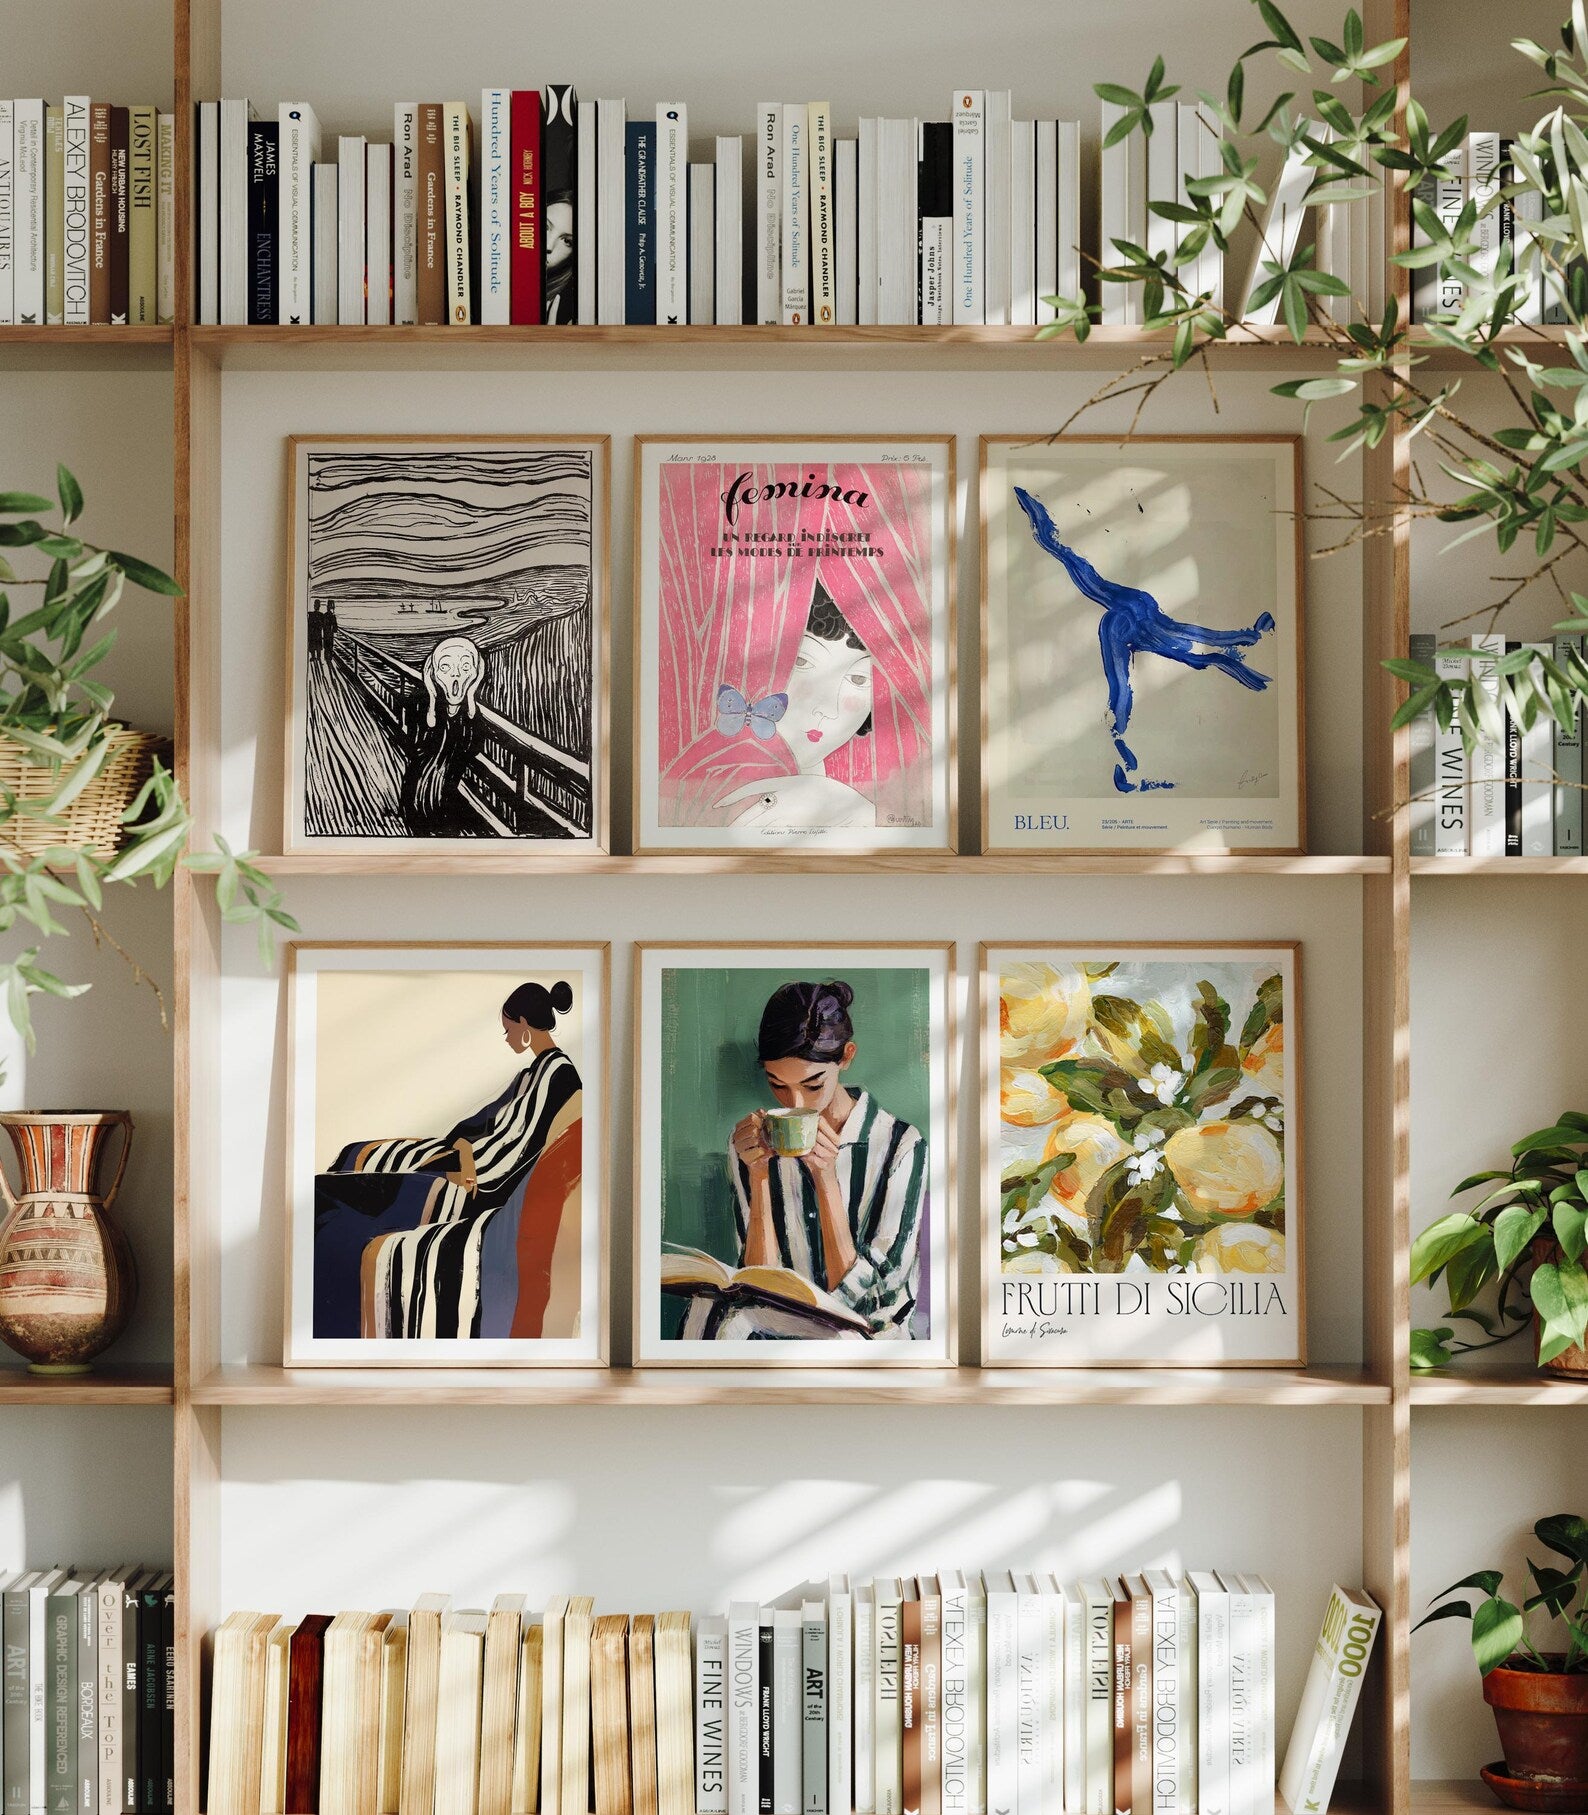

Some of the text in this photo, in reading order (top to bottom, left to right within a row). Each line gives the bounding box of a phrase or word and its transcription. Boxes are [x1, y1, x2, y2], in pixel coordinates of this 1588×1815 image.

[29, 119, 39, 139] Detail
[66, 102, 87, 179] ALEXEY
[452, 115, 460, 132] THE
[817, 115, 825, 132] THE
[28, 148, 39, 194] Contemporary
[133, 112, 152, 208] LOST FISH
[254, 133, 265, 184] MAXWELL
[265, 140, 276, 176] JAMES
[291, 128, 299, 172] ESSENTIALS
[453, 155, 461, 182] SLEEP
[523, 149, 533, 185] NICK HORNBY
[669, 128, 677, 172] ESSENTIALS
[818, 155, 826, 182] SLEEP
[118, 149, 126, 233] NEW URBAN HOUSING
[291, 172, 299, 183] OF
[291, 184, 299, 209] VISUAL
[402, 113, 413, 280] Ron Arad No Discipline
[490, 92, 502, 294] Hundred Years of Solitude
[519, 191, 535, 209] BOY
[638, 135, 646, 225] THE GRANDFATHER CLAUSE
[669, 172, 677, 183] OF
[669, 184, 677, 209] VISUAL
[765, 113, 776, 280] Ron Arad No Discipline
[791, 124, 801, 268] One Hundred Years of Solitude
[29, 195, 39, 232] Residential
[95, 171, 107, 269] Gardens in France
[427, 172, 437, 268] Gardens in France
[454, 194, 463, 244] RAYMOND
[519, 221, 535, 250] ABOUT
[819, 194, 828, 244] RAYMOND
[963, 156, 974, 309] One Hundred Years of Solitude
[29, 233, 39, 272] Architecture
[66, 186, 87, 314] BRODOVITCH
[291, 209, 299, 272] COMMUNICATION
[669, 209, 677, 272] COMMUNICATION
[256, 232, 272, 321] ENCHANTRESS
[456, 247, 464, 298] CHANDLER
[821, 247, 829, 298] CHANDLER
[927, 246, 937, 307] Jasper Johns
[721, 471, 870, 527] femina
[710, 547, 733, 557] LES
[738, 547, 783, 557] MODES
[787, 547, 804, 557] DE
[723, 533, 740, 542] UN
[744, 533, 796, 542] REGARD
[1509, 734, 1517, 758] LLOYD
[1441, 747, 1464, 830] WINES
[1014, 815, 1070, 830] BLEU.
[1001, 1281, 1288, 1317] FRUTTI DI SICILIA
[7, 1644, 27, 1680] ART
[56, 1615, 68, 1662] GRAPHIC
[56, 1664, 68, 1703] DESIGN
[102, 1594, 117, 1761] Over the Top
[126, 1662, 137, 1691] EAMES
[146, 1643, 156, 1710] ARNE JACOBSEN
[166, 1646, 175, 1710] EERO SAARINEN
[734, 1627, 753, 1708] WINDOWS
[806, 1667, 824, 1700] ART
[81, 1681, 94, 1740] BORDEAUX
[702, 1660, 723, 1793] FINE WINES
[739, 1716, 748, 1748] BERGDORF
[762, 1686, 770, 1758] FRANK LLOYD WRIGHT
[56, 1705, 68, 1774] REFERENCED
[739, 1749, 748, 1783] GOODMAN
[127, 1777, 135, 1806] ASSOULINE
